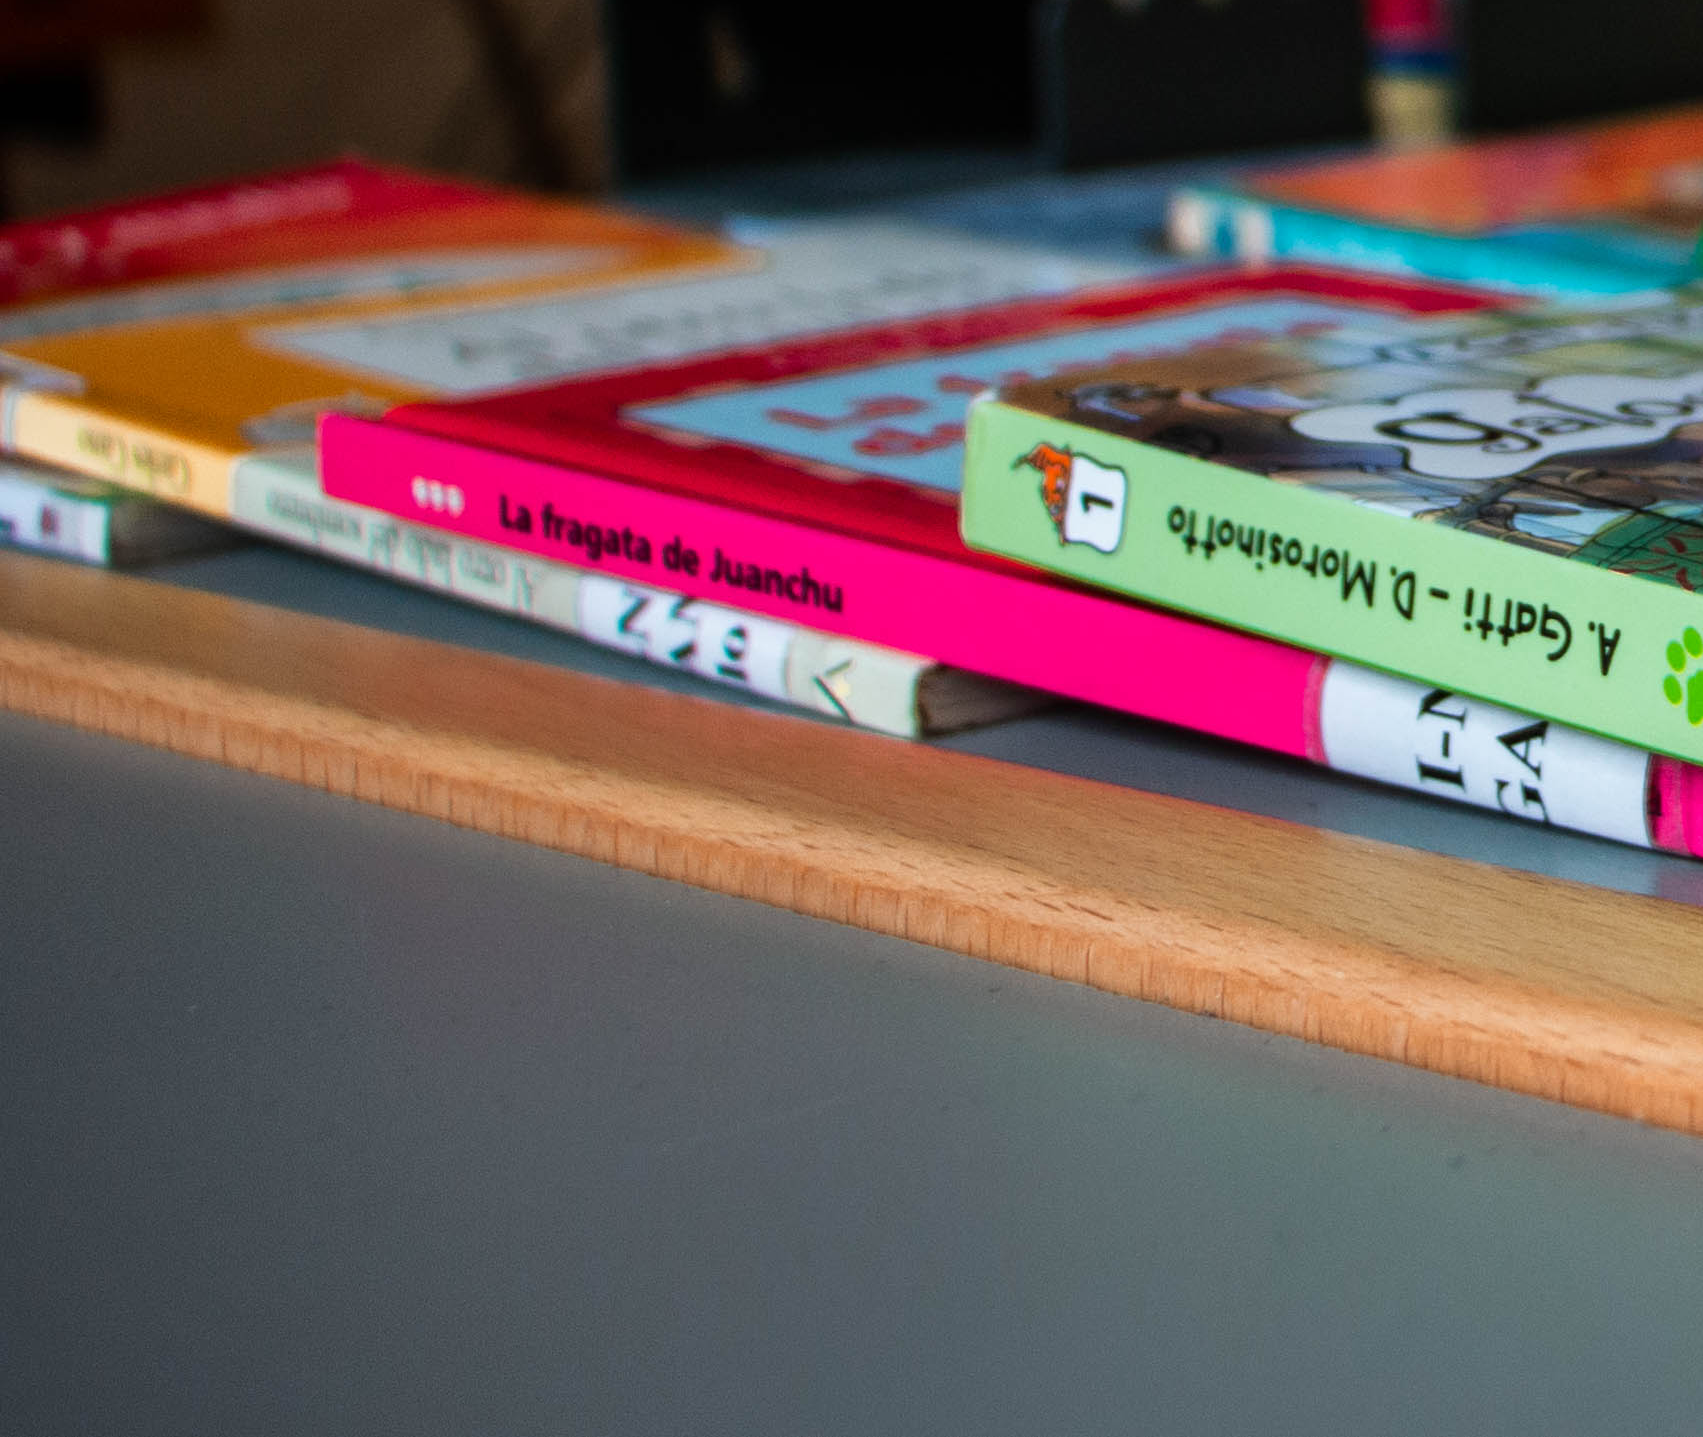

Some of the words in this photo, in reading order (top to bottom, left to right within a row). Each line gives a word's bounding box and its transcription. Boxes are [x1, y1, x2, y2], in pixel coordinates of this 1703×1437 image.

[1081, 491, 1114, 513] 1
[498, 494, 532, 534] La
[541, 502, 652, 562] fragata
[662, 534, 699, 577] de
[709, 547, 844, 613] Juanchu
[1166, 505, 1377, 610] Morosinotto
[1390, 565, 1416, 620] D.
[1463, 587, 1572, 662] Gatti
[1588, 621, 1621, 676] A.
